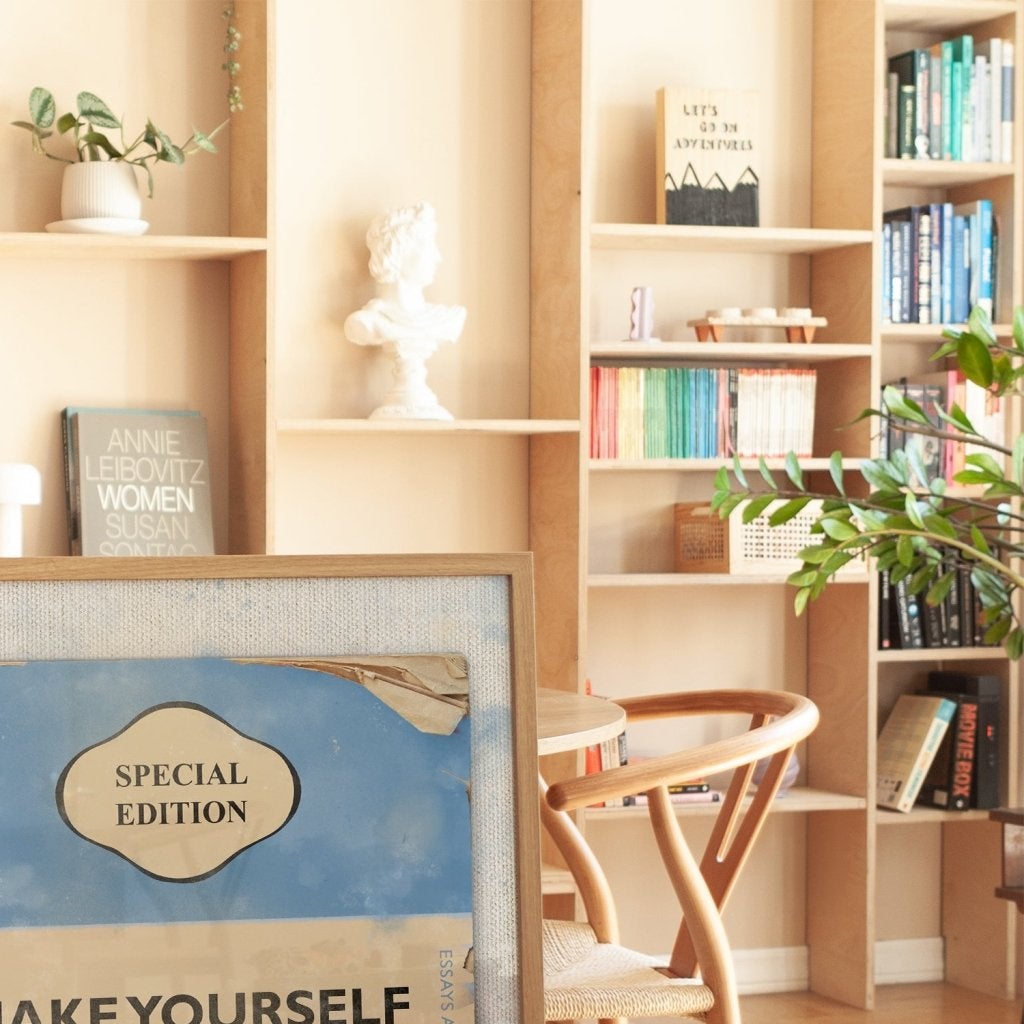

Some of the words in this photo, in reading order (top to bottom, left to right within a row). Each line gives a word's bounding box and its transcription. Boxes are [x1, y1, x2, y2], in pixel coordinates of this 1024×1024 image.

[674, 139, 753, 151] ADVENTURES
[107, 428, 181, 456] ANNIE
[85, 455, 206, 485] LEIBOVITZ
[97, 484, 194, 513] WOMEN
[106, 513, 189, 540] SUSAN
[957, 703, 979, 759] MOVIE
[115, 762, 248, 787] SPECIAL
[952, 761, 973, 797] BOX
[115, 800, 248, 826] EDITION
[439, 949, 454, 1011] ESSAYS
